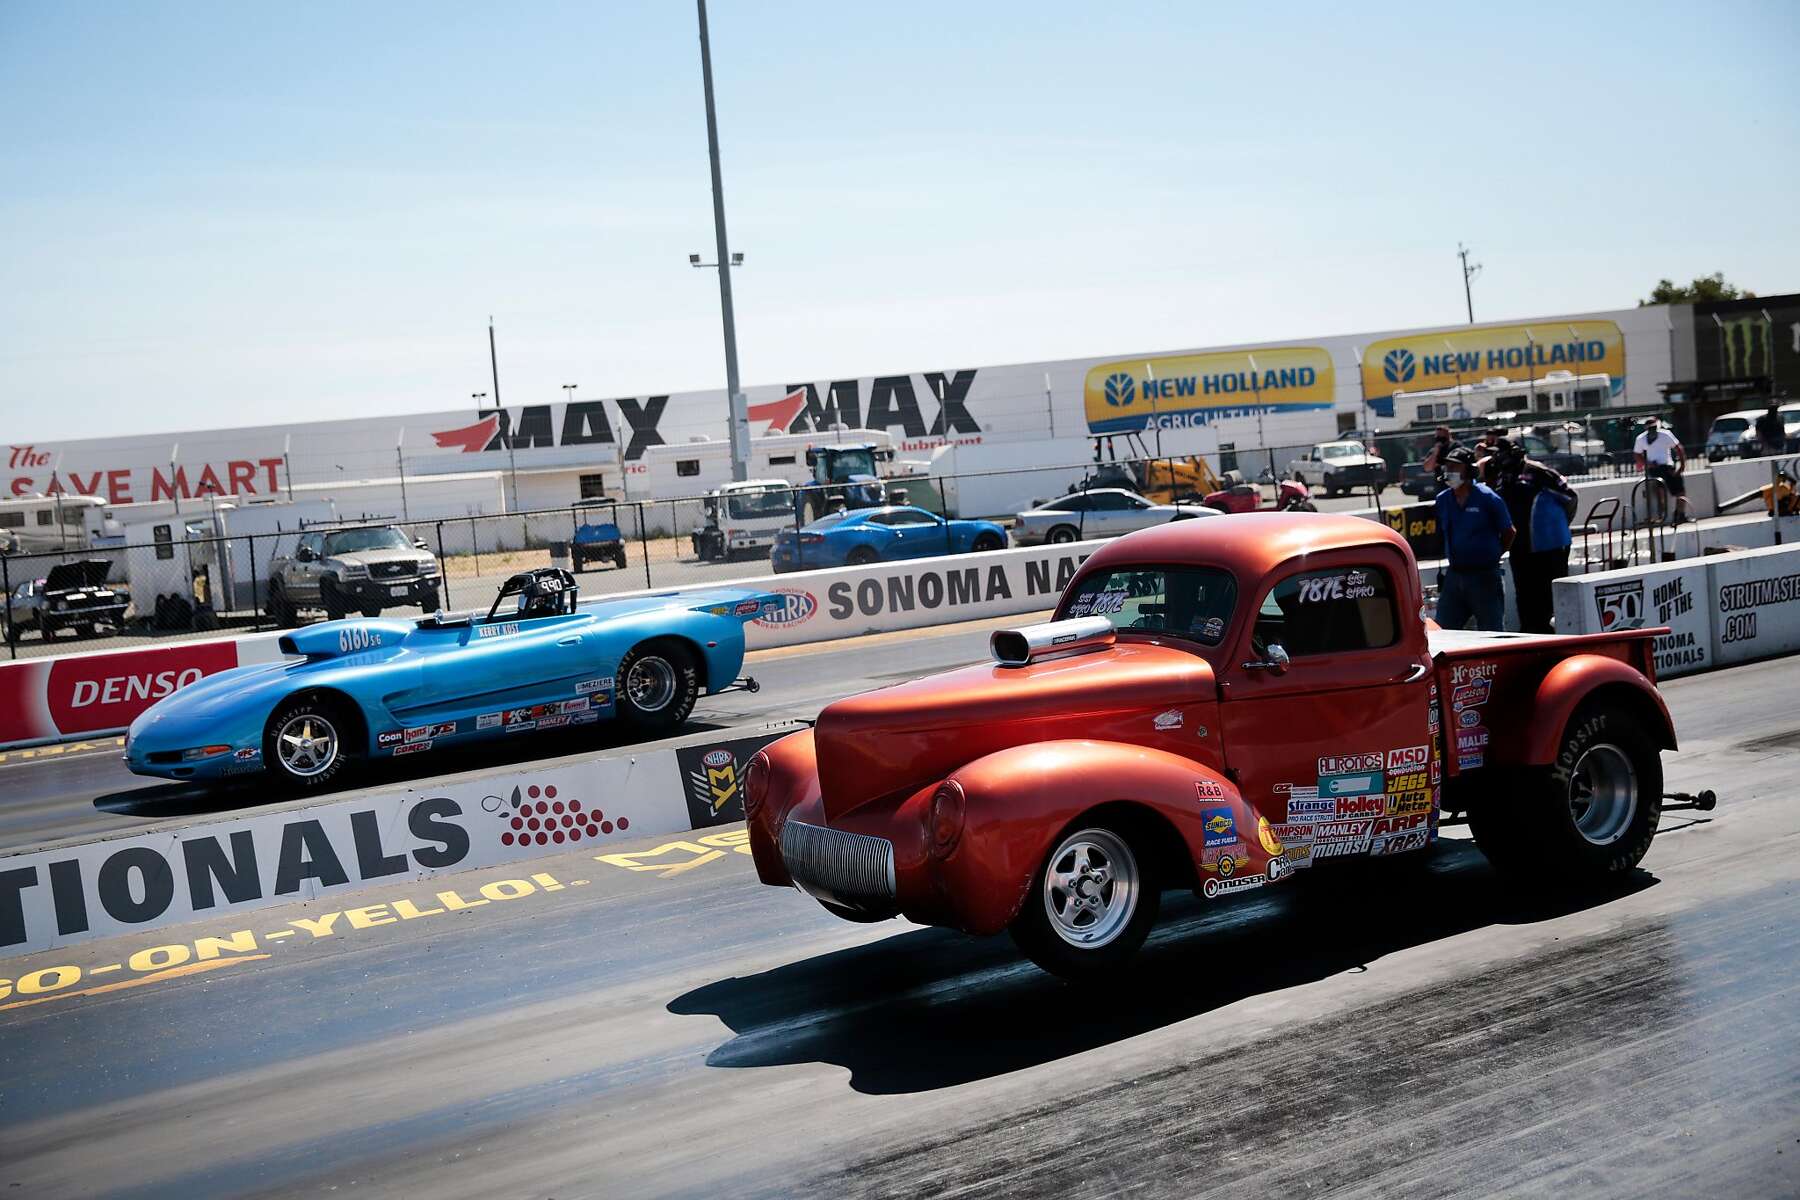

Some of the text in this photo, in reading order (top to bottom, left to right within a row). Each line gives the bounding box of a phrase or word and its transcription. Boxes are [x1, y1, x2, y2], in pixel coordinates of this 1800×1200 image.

[1423, 340, 1606, 376] NEW HOLLAND
[1142, 367, 1316, 399] NEW HOLLAND
[9, 445, 51, 470] The
[11, 457, 284, 504] SAVE MART
[828, 564, 1012, 620] SONOMA
[1298, 575, 1346, 603] 787E
[1653, 576, 1683, 602] HOME
[1659, 592, 1694, 625] OF THE
[479, 623, 521, 639] KERRY KOST
[1722, 612, 1757, 644] .COM
[71, 667, 203, 708] DENSO
[378, 732, 402, 743] Coan
[707, 750, 729, 765] NHRA
[1390, 748, 1426, 768] MSD
[1198, 785, 1222, 797] R&B
[1387, 772, 1428, 793] JEGS
[1288, 800, 1335, 812] Strange
[1336, 795, 1384, 816] Holley
[1402, 791, 1425, 801] Auto
[1206, 818, 1233, 831] SUNOCO
[1318, 821, 1366, 838] MANLEY
[1373, 814, 1427, 836] ARP
[1312, 839, 1370, 859] MOROSO
[0, 797, 470, 948] TIONALS
